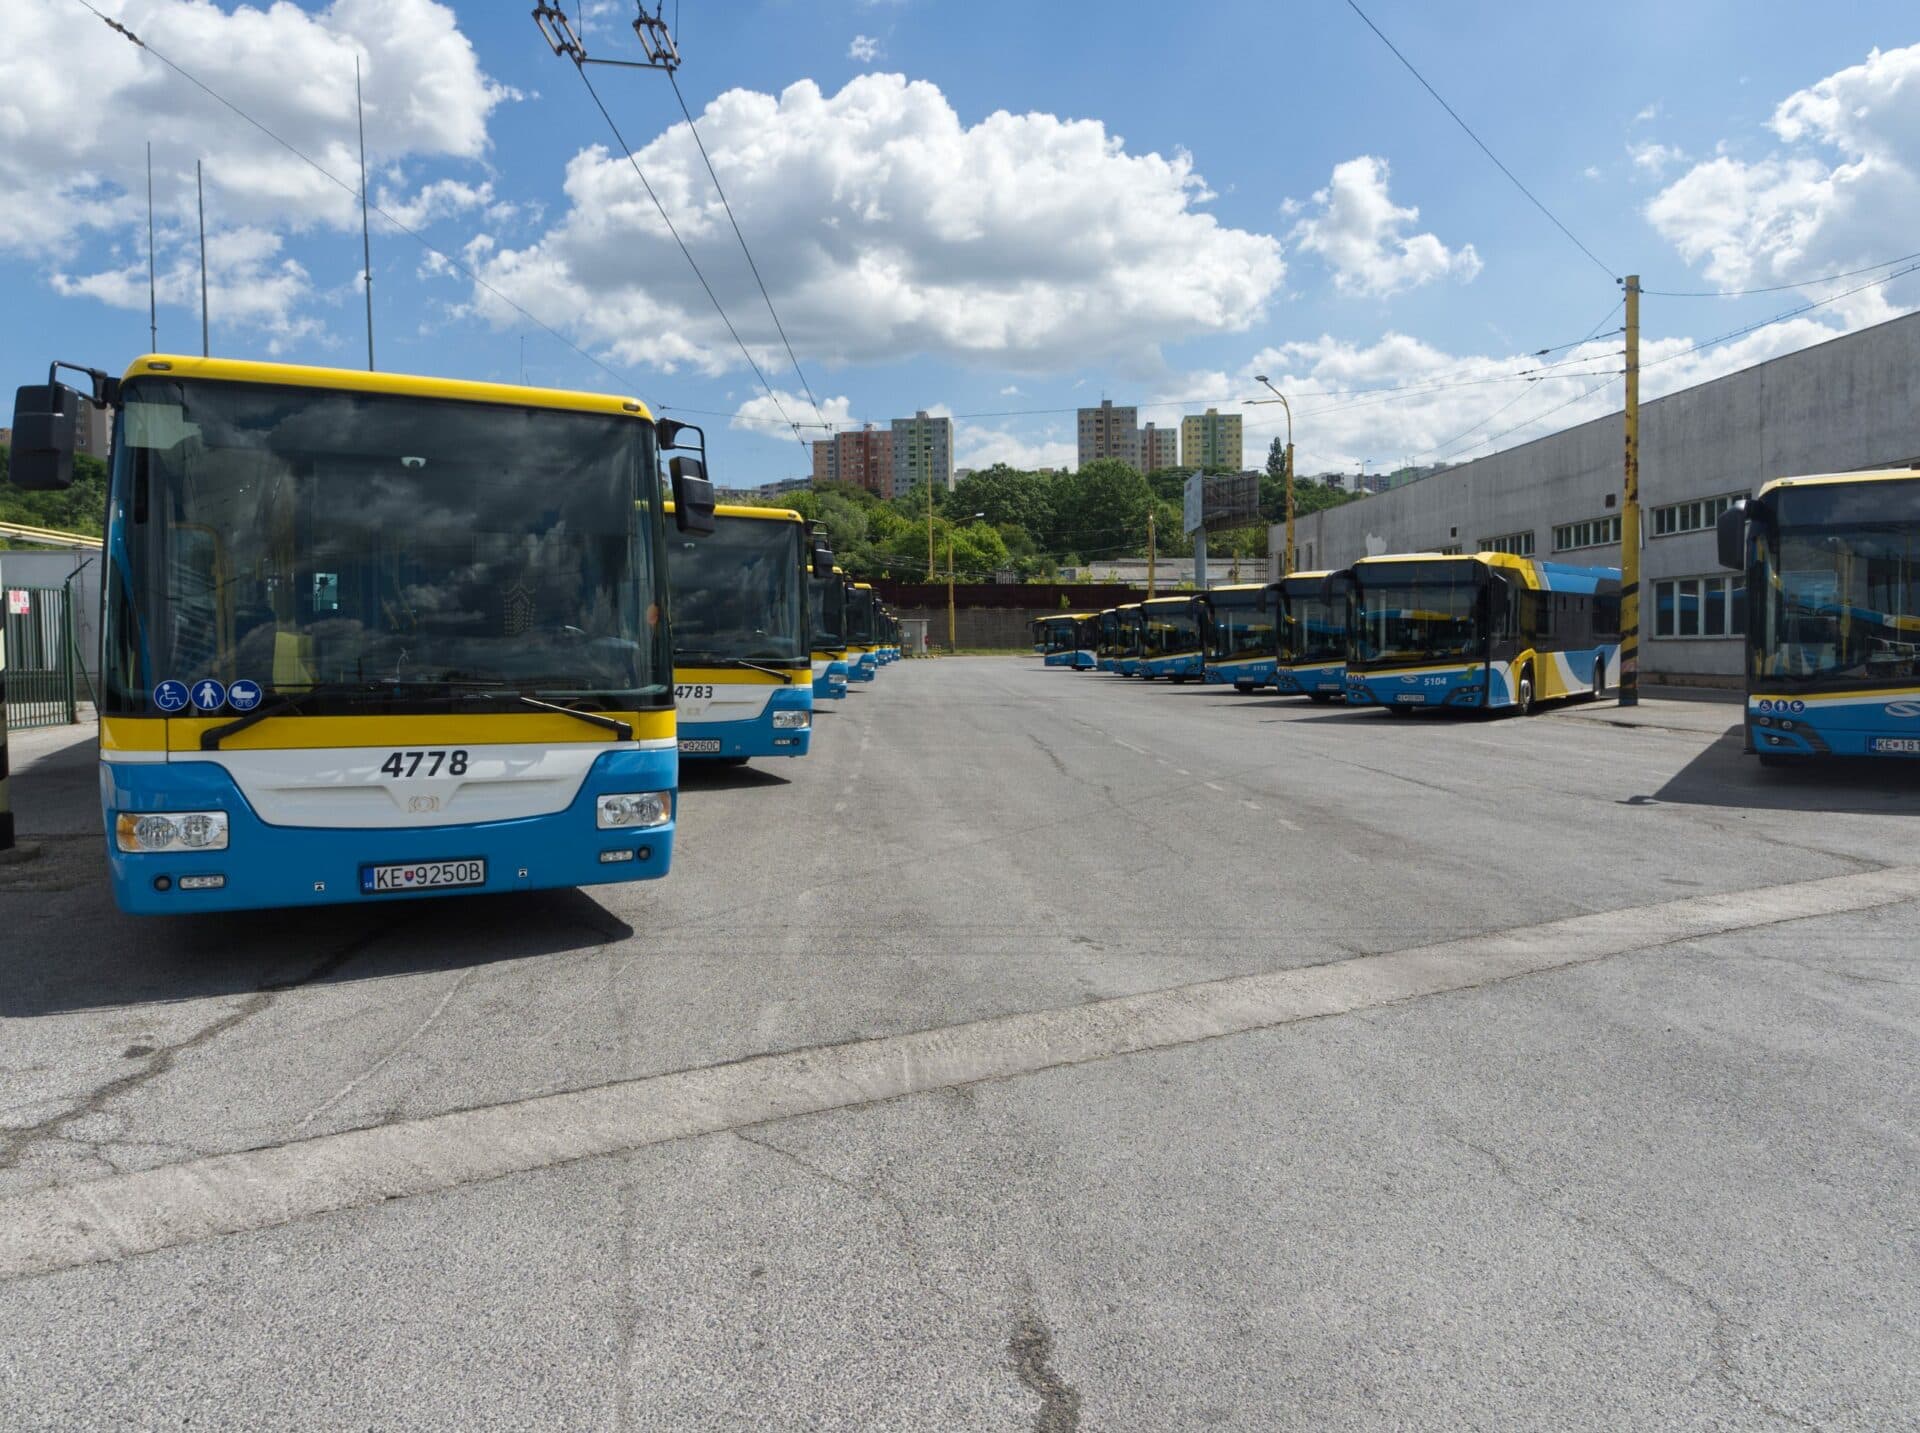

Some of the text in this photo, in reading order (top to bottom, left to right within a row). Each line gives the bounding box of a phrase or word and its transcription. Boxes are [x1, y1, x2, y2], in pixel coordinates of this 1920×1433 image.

[1423, 677, 1447, 686] 5104
[674, 685, 713, 699] 4783
[381, 749, 469, 778] 4778
